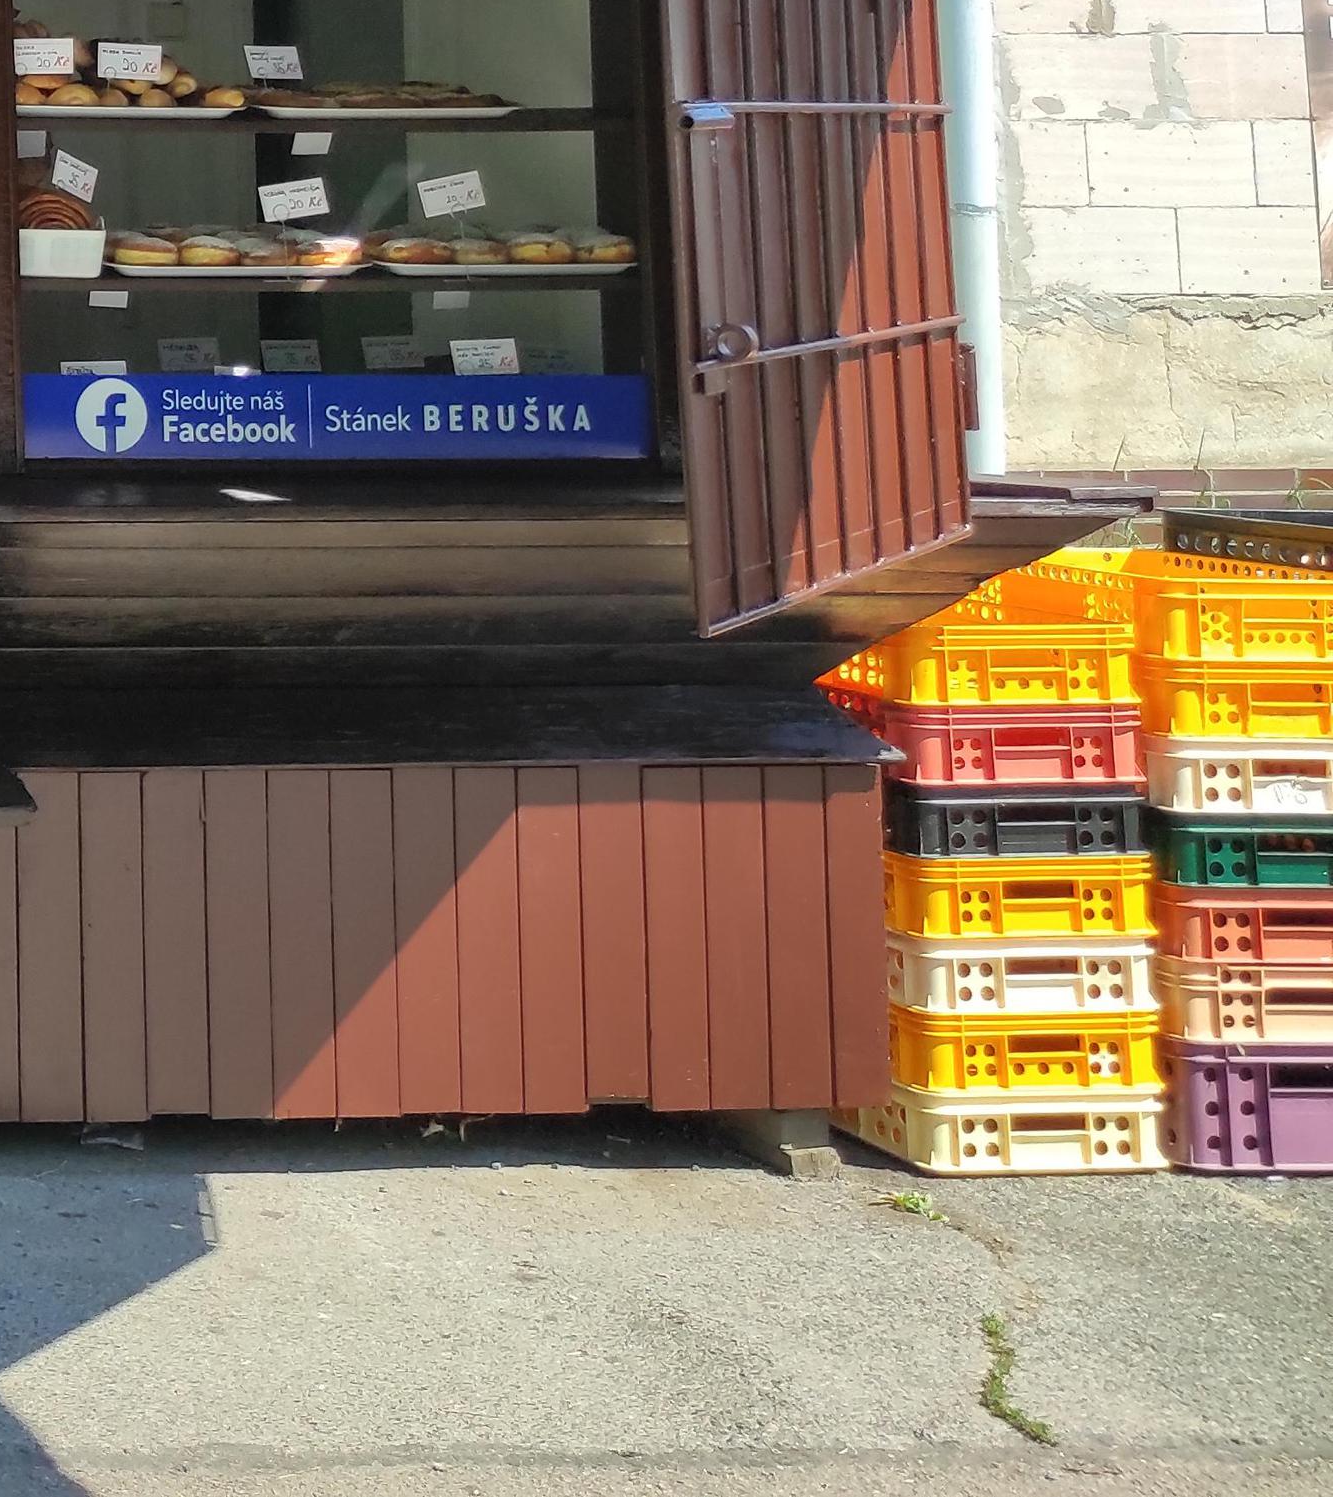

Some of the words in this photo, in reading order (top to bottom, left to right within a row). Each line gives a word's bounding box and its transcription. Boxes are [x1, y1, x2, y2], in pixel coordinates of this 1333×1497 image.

[162, 389, 244, 412] Sledujte
[249, 388, 284, 410] náš
[325, 405, 411, 432] Stánek
[423, 396, 591, 432] BERUŠKA
[163, 415, 296, 443] Facebook
